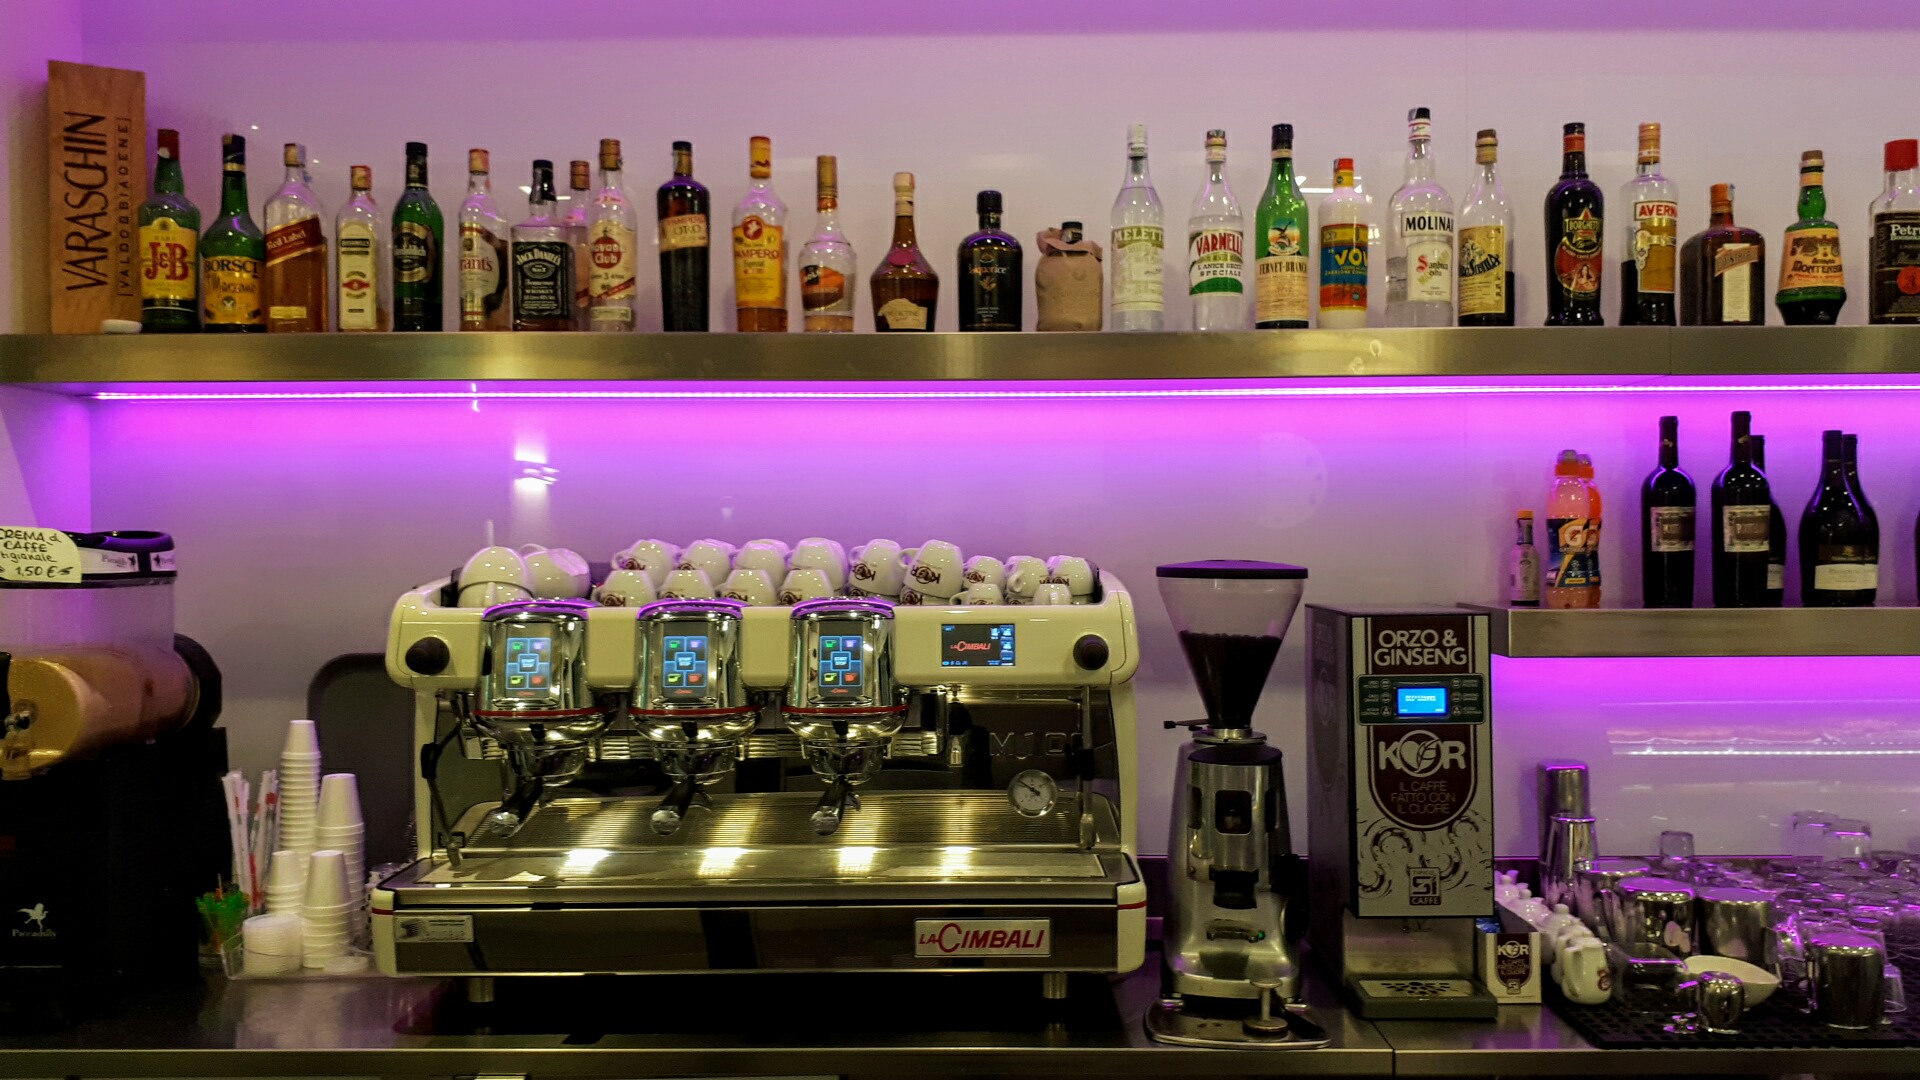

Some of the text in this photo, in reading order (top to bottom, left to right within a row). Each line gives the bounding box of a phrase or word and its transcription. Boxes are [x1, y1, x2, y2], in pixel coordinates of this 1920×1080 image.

[62, 112, 111, 291] VARASCHIN
[266, 230, 306, 250] Red Label
[145, 242, 189, 281] J&B
[1378, 629, 1457, 648] ORZO &
[1374, 647, 1467, 666] GINSENG
[1378, 729, 1466, 777] KOR
[1390, 792, 1456, 803] FATTO CON
[1408, 803, 1451, 814] CUORE
[938, 922, 1046, 953] CIMBALI
